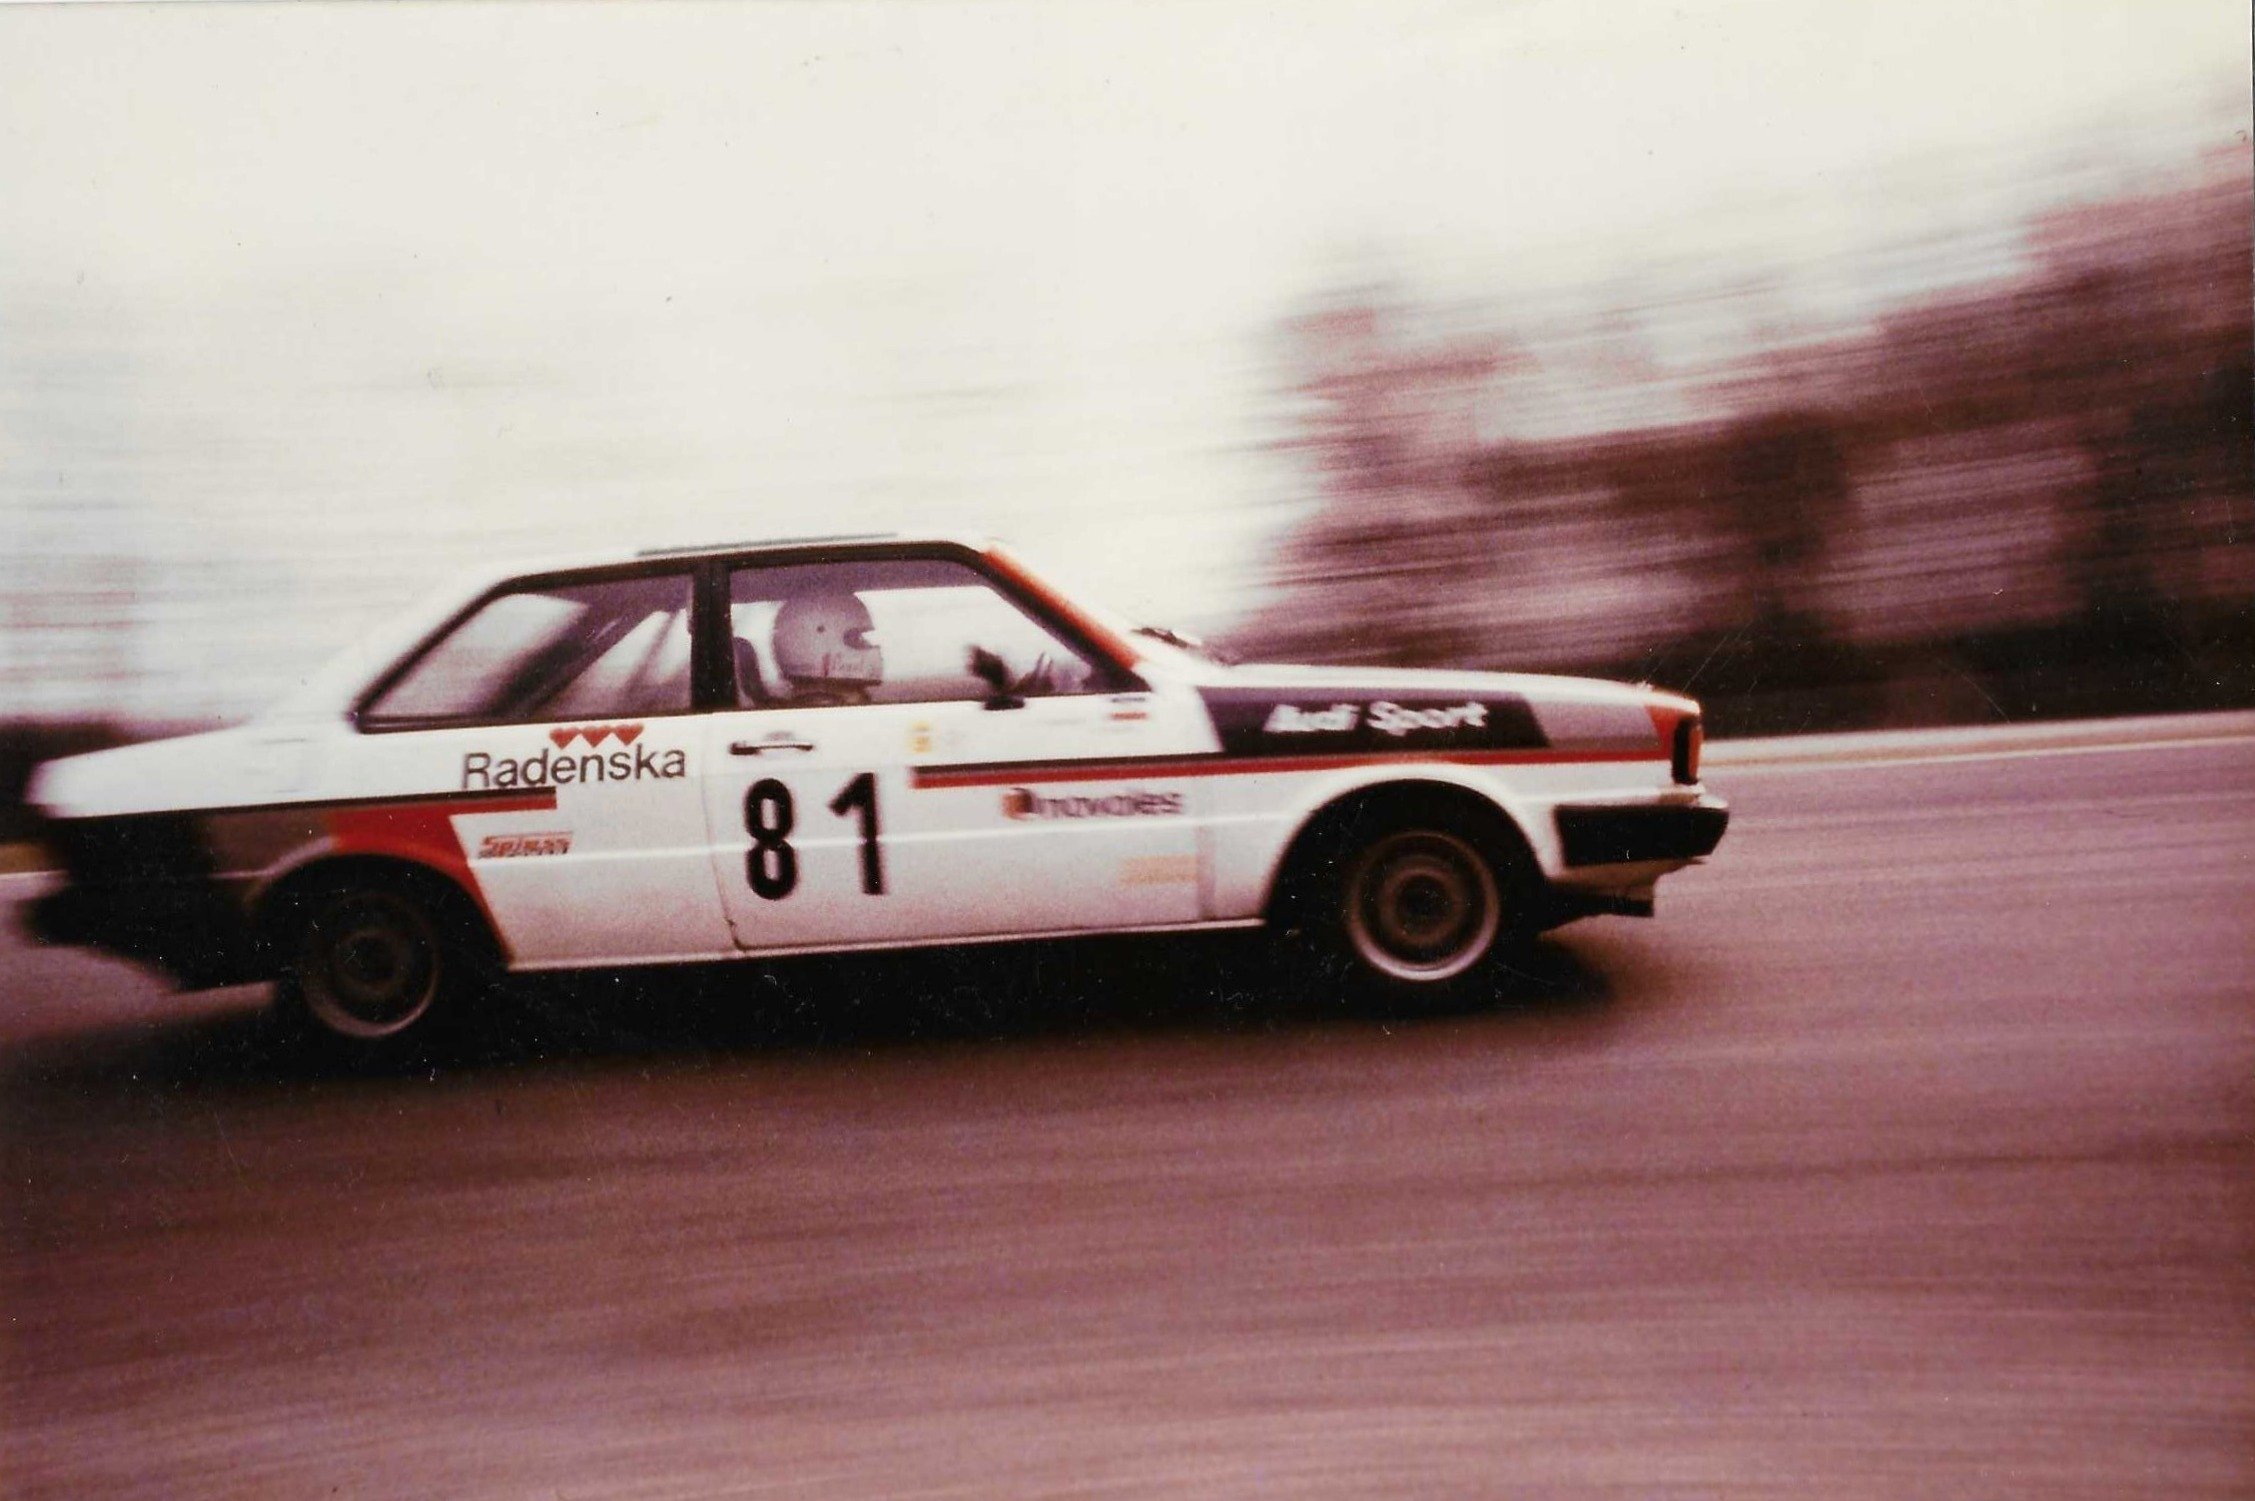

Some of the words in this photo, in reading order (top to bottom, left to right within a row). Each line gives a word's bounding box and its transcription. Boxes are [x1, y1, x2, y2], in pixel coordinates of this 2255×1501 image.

[1367, 701, 1488, 737] Sport
[462, 743, 686, 788] Radenska
[744, 773, 884, 900] 81
